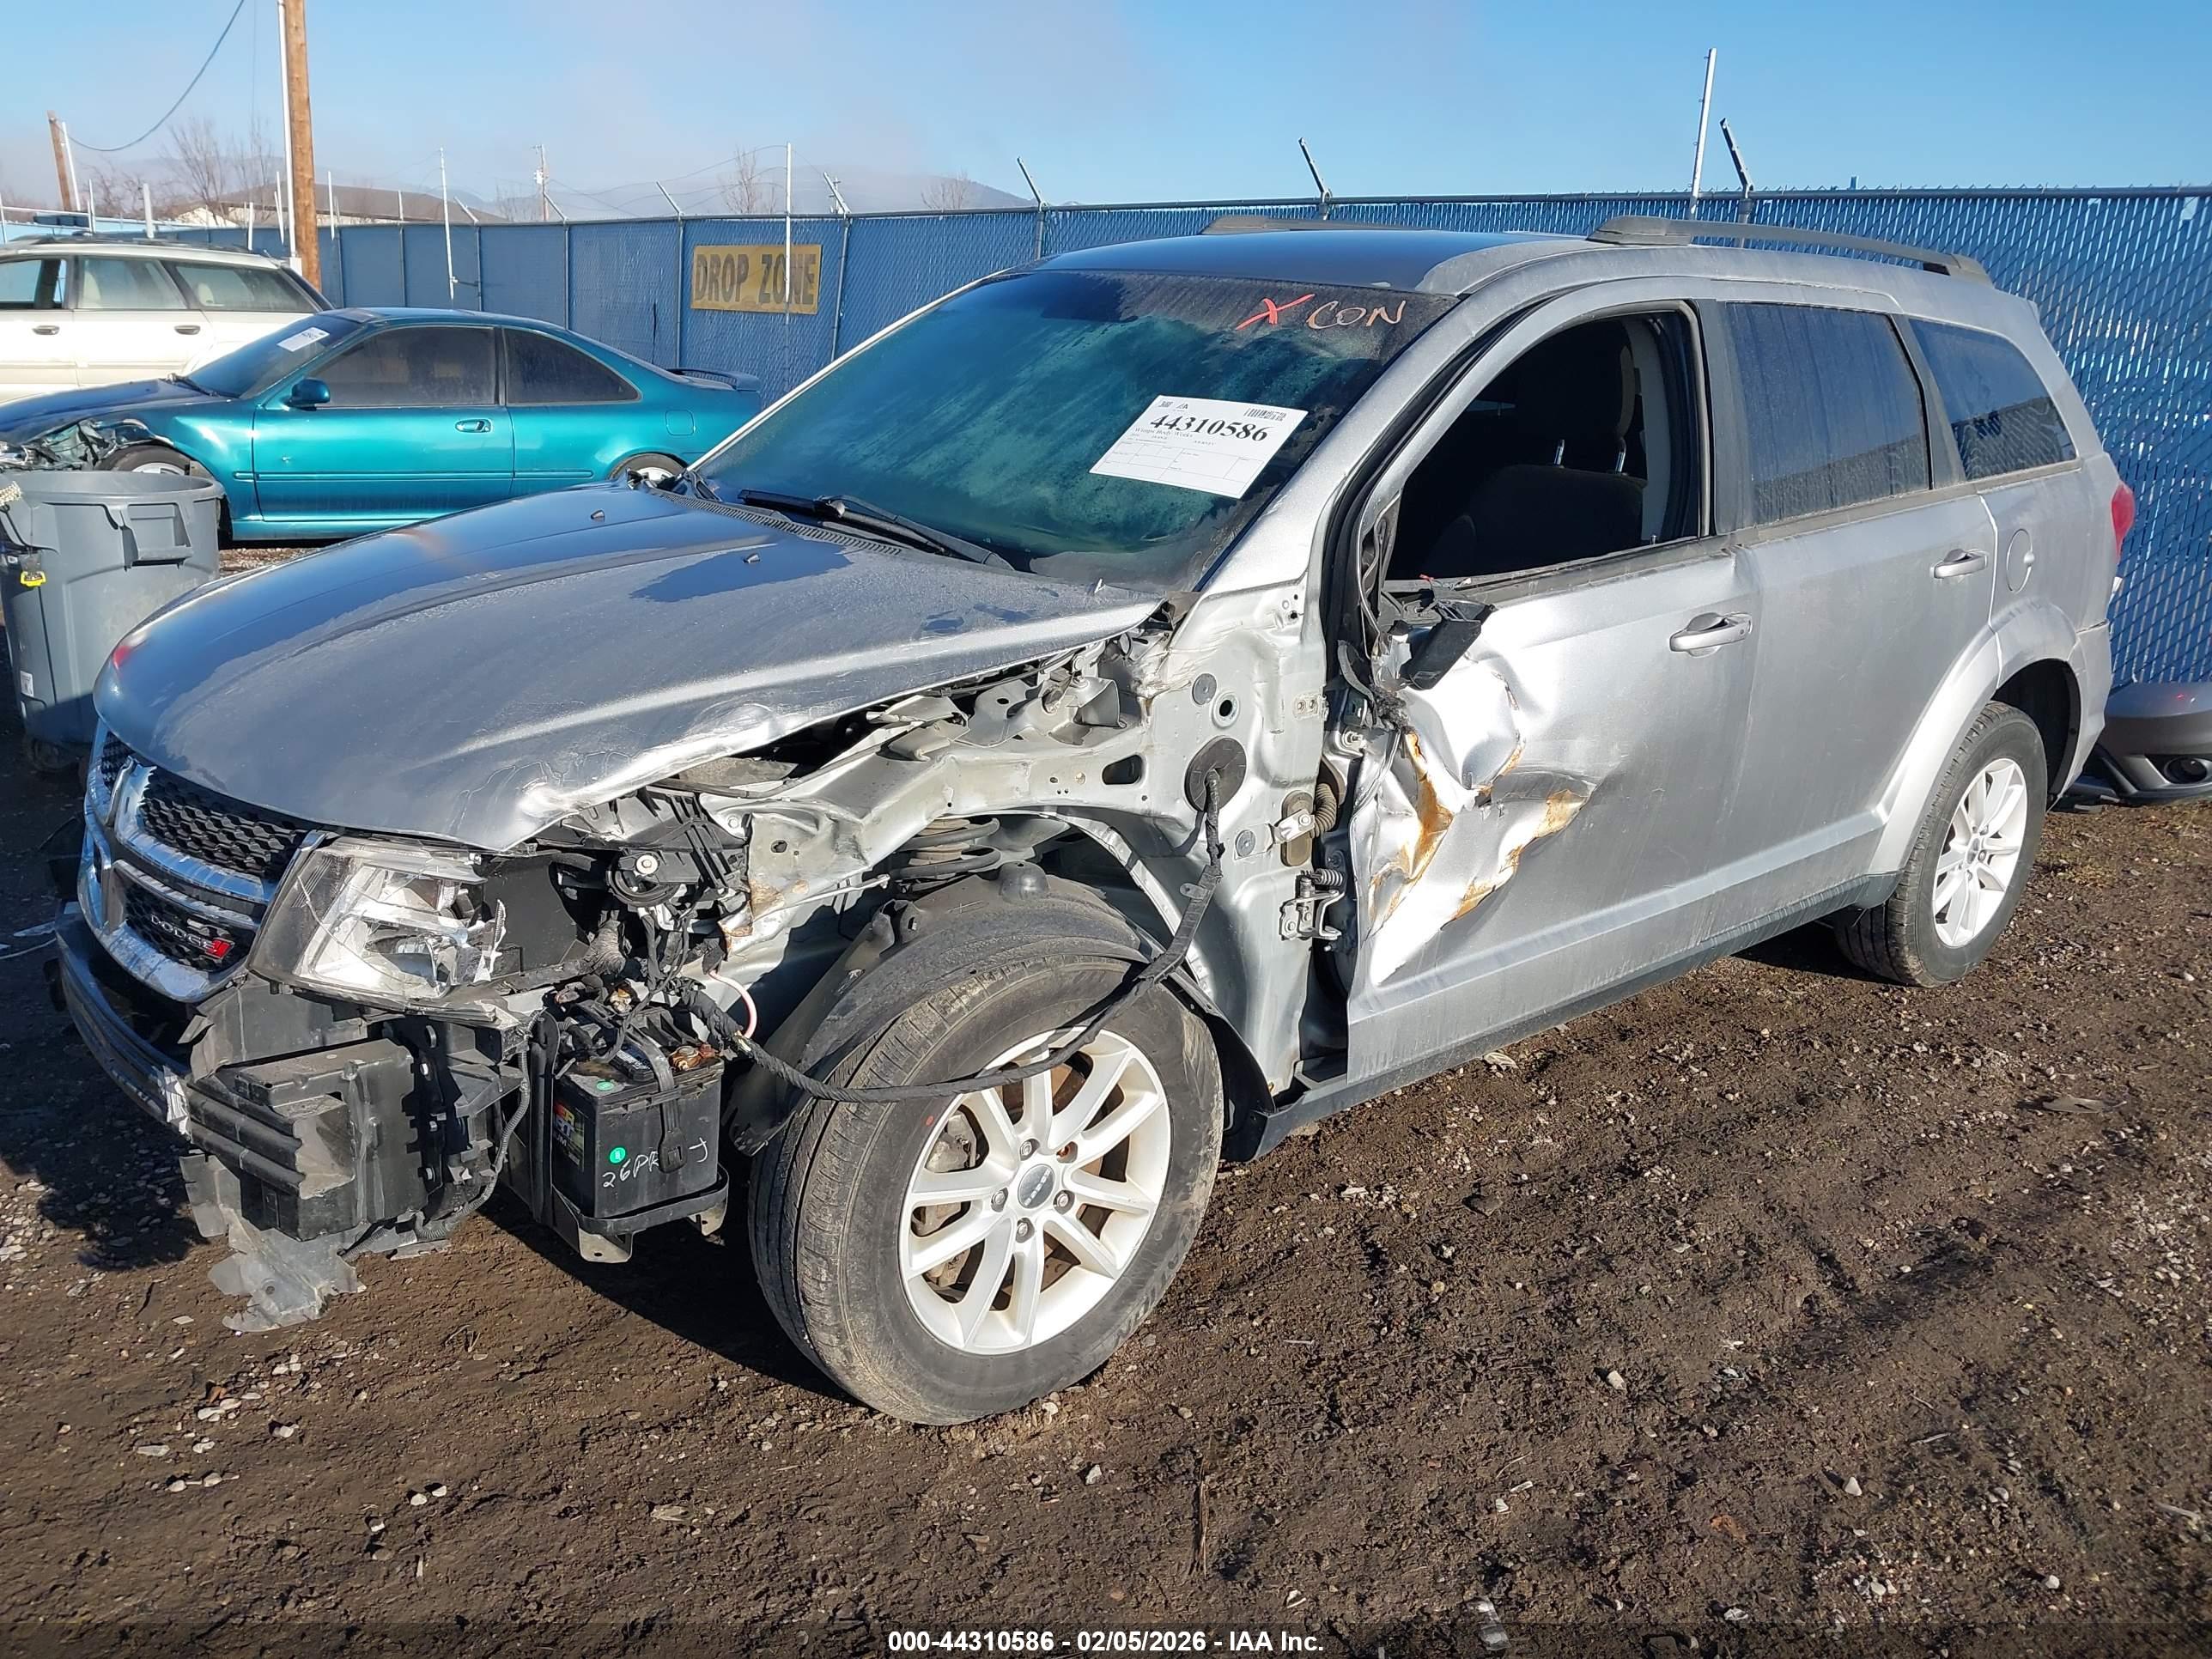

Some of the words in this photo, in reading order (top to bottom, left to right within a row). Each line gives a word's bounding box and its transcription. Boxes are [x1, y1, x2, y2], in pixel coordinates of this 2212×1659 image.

[695, 253, 750, 302] DROP
[758, 253, 817, 305] ZONE
[1150, 414, 1275, 441] 44310586
[151, 913, 215, 950] DODGE
